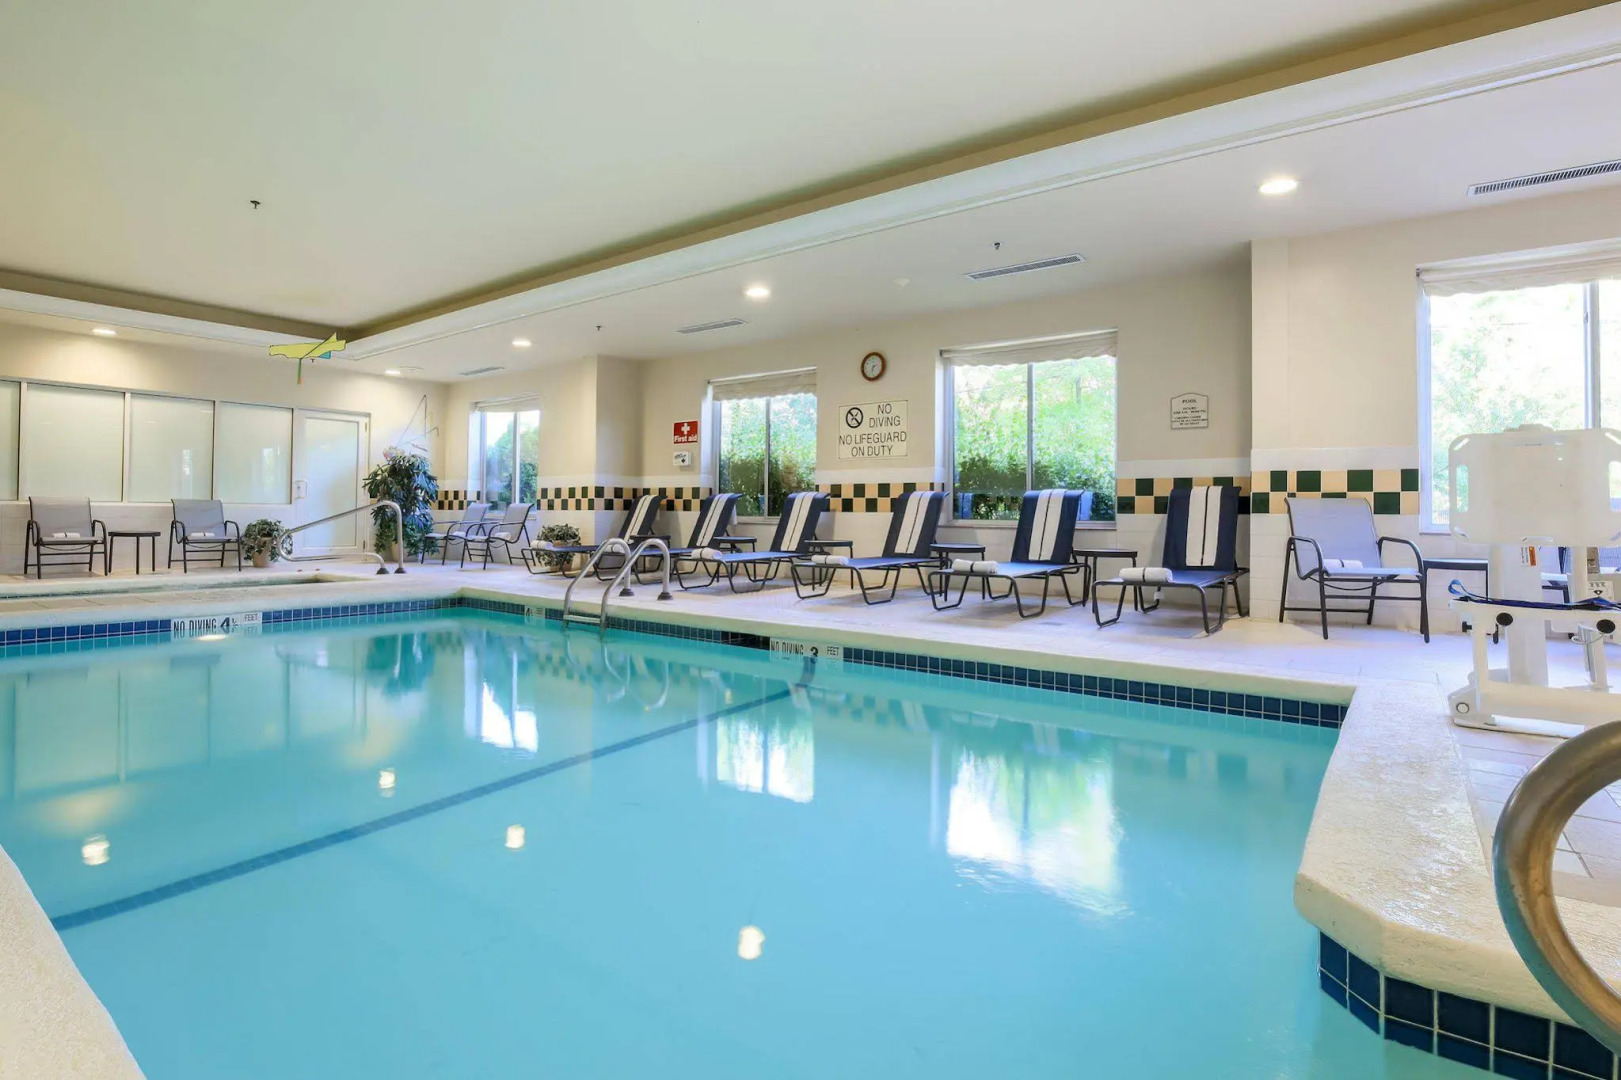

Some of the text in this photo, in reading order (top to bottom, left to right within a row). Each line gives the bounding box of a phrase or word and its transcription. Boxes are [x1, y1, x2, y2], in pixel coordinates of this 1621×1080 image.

[878, 403, 892, 415] NO
[869, 415, 901, 428] DIVING
[674, 433, 698, 443] First aid
[839, 434, 852, 445] NO
[855, 431, 907, 445] LIFEGUARD
[851, 446, 865, 457] ON
[867, 445, 893, 456] DUTY
[173, 620, 185, 631] NO
[189, 618, 216, 631] DIVING
[244, 613, 258, 622] FEET
[771, 641, 839, 657] NO DIVING 3 FEET
